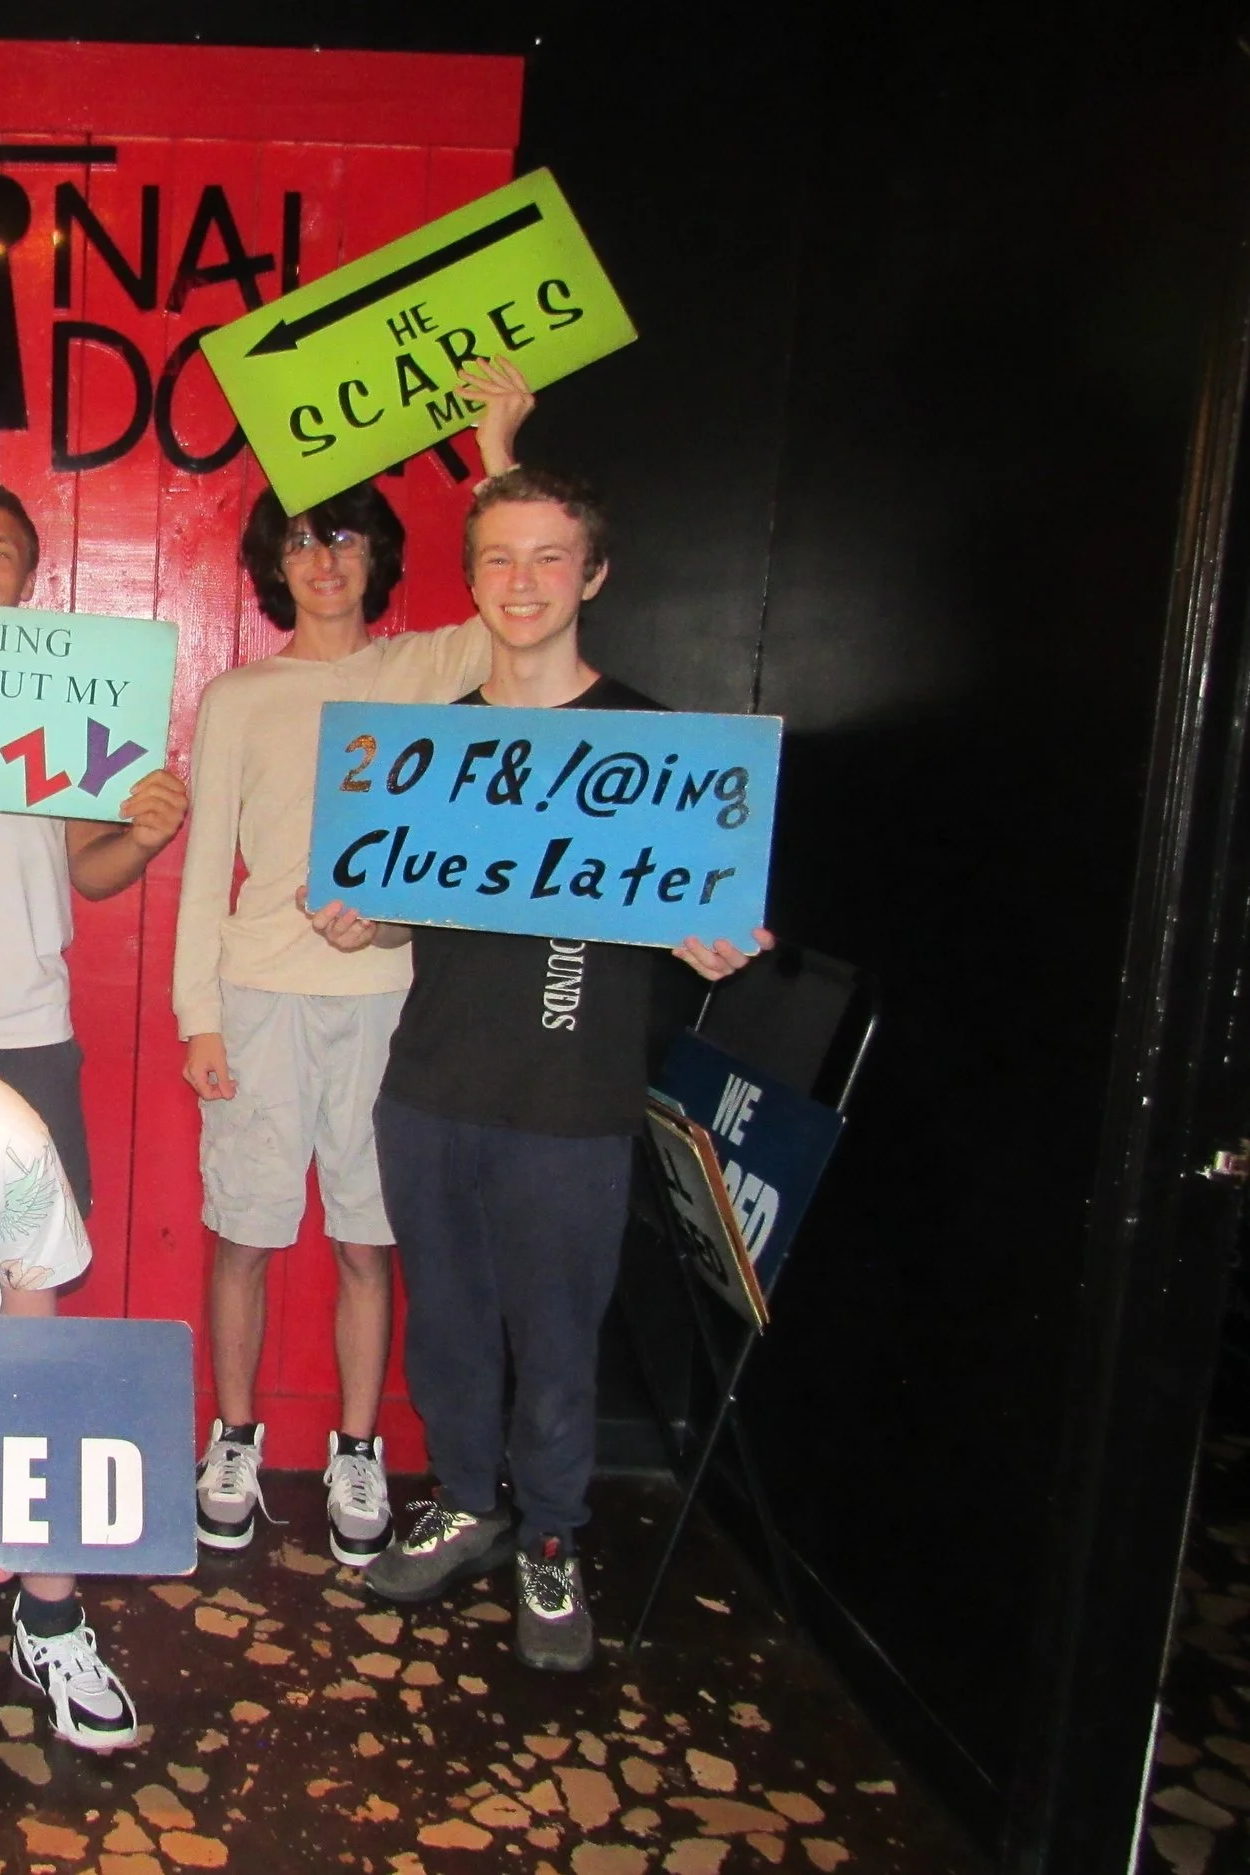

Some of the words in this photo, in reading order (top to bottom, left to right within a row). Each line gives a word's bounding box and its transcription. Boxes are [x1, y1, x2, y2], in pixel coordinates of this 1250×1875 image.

[387, 301, 439, 347] HE
[289, 279, 584, 458] SCARES
[66, 676, 131, 708] MY
[338, 734, 435, 796] 20
[332, 826, 518, 896] Clues
[530, 837, 737, 907] Later
[712, 1072, 763, 1147] WE
